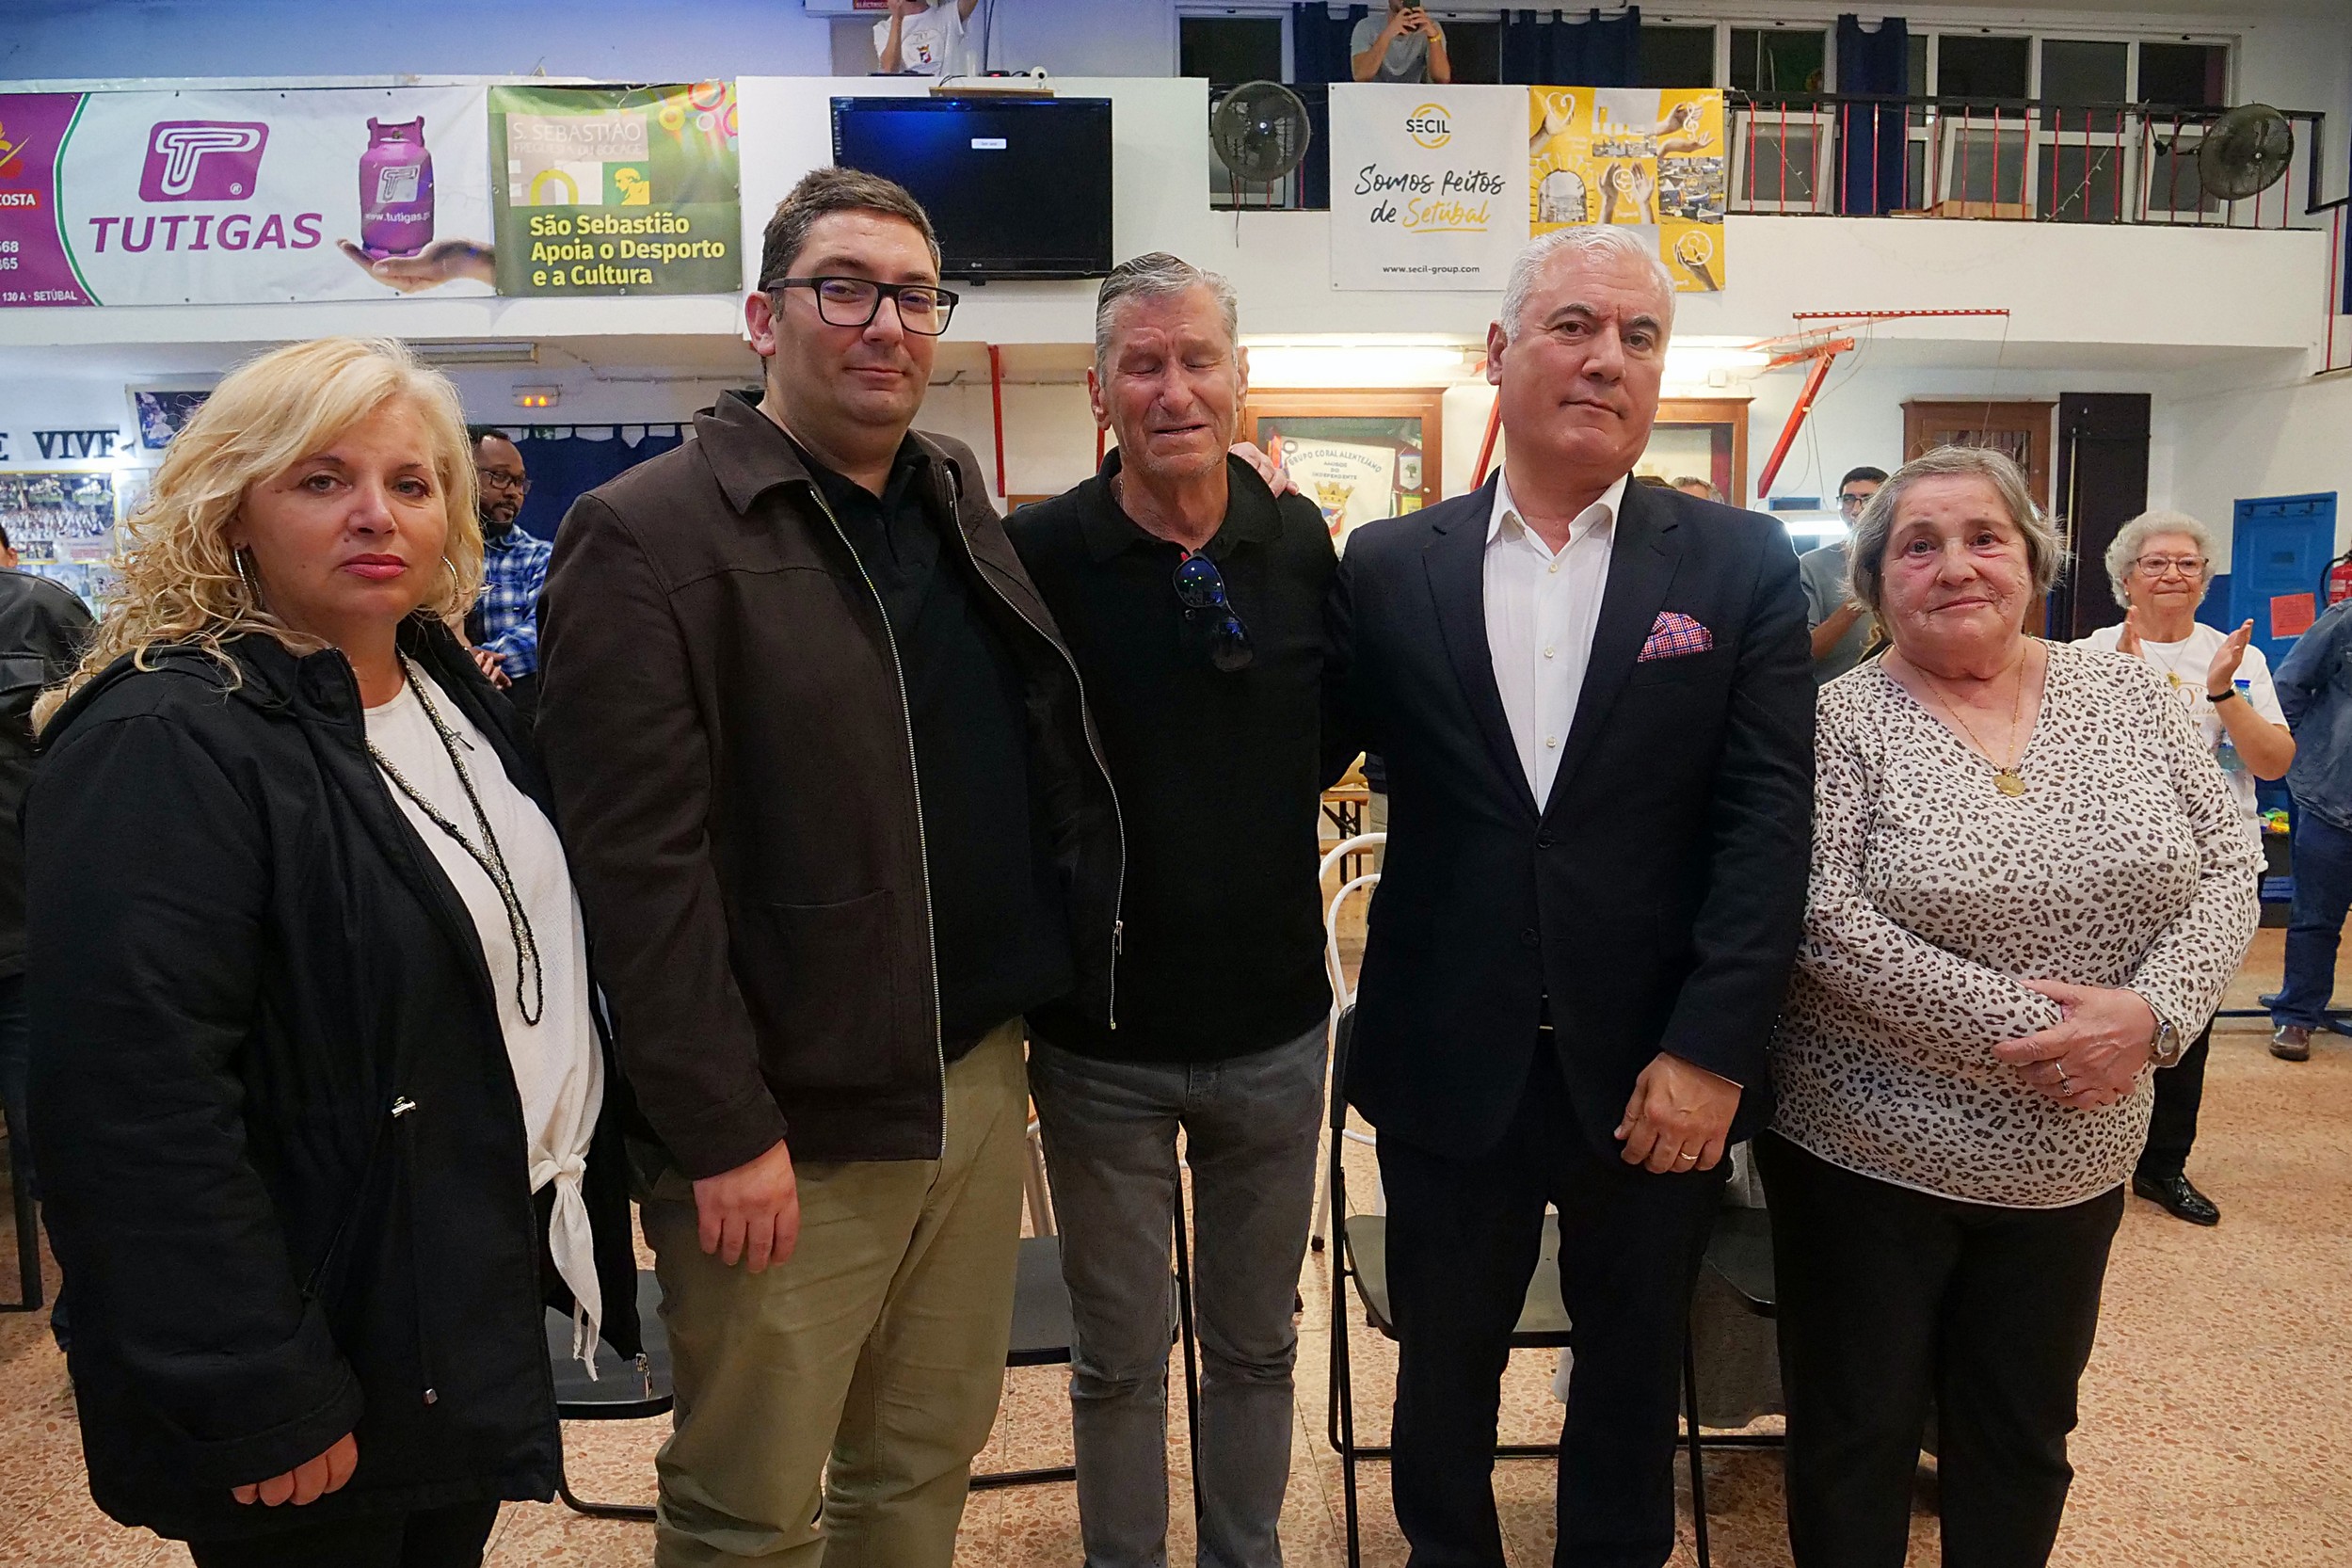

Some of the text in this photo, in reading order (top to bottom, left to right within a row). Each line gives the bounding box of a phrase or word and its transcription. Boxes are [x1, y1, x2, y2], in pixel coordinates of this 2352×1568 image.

[513, 120, 641, 143] S. SEBASTIÃO
[1406, 119, 1450, 134] SECIL
[1354, 163, 1435, 196] Somos
[0, 193, 36, 206] OSTA
[529, 211, 690, 237] São Sebastião
[1370, 197, 1491, 228] de Setúbal
[88, 213, 323, 253] TUTIGAS
[0, 241, 19, 253] 68
[530, 237, 726, 266] Apoia o Desporto
[532, 264, 653, 286] e a Cultura
[1383, 264, 1480, 275] www.secil-group.com
[3, 292, 18, 302] 130
[34, 288, 77, 301] SETÚBAL
[1288, 449, 1383, 472] GRUPO CORAL ALENTEJANO
